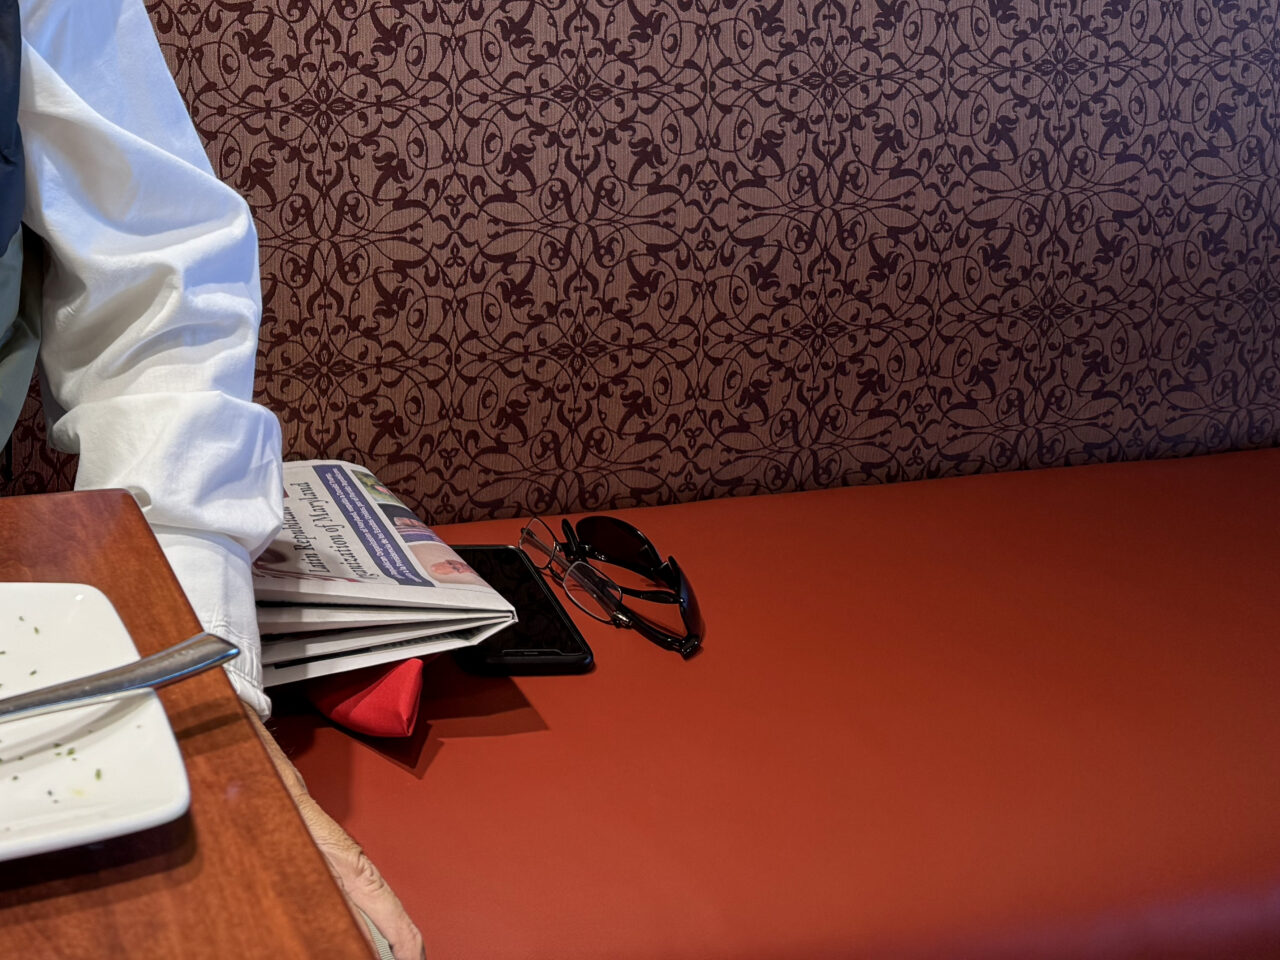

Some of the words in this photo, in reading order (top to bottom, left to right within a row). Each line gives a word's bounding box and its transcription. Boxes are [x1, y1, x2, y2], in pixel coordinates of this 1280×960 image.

[289, 482, 333, 522] Maryland
[282, 506, 317, 551] Republican
[314, 523, 345, 533] of
[301, 553, 331, 573] Latin
